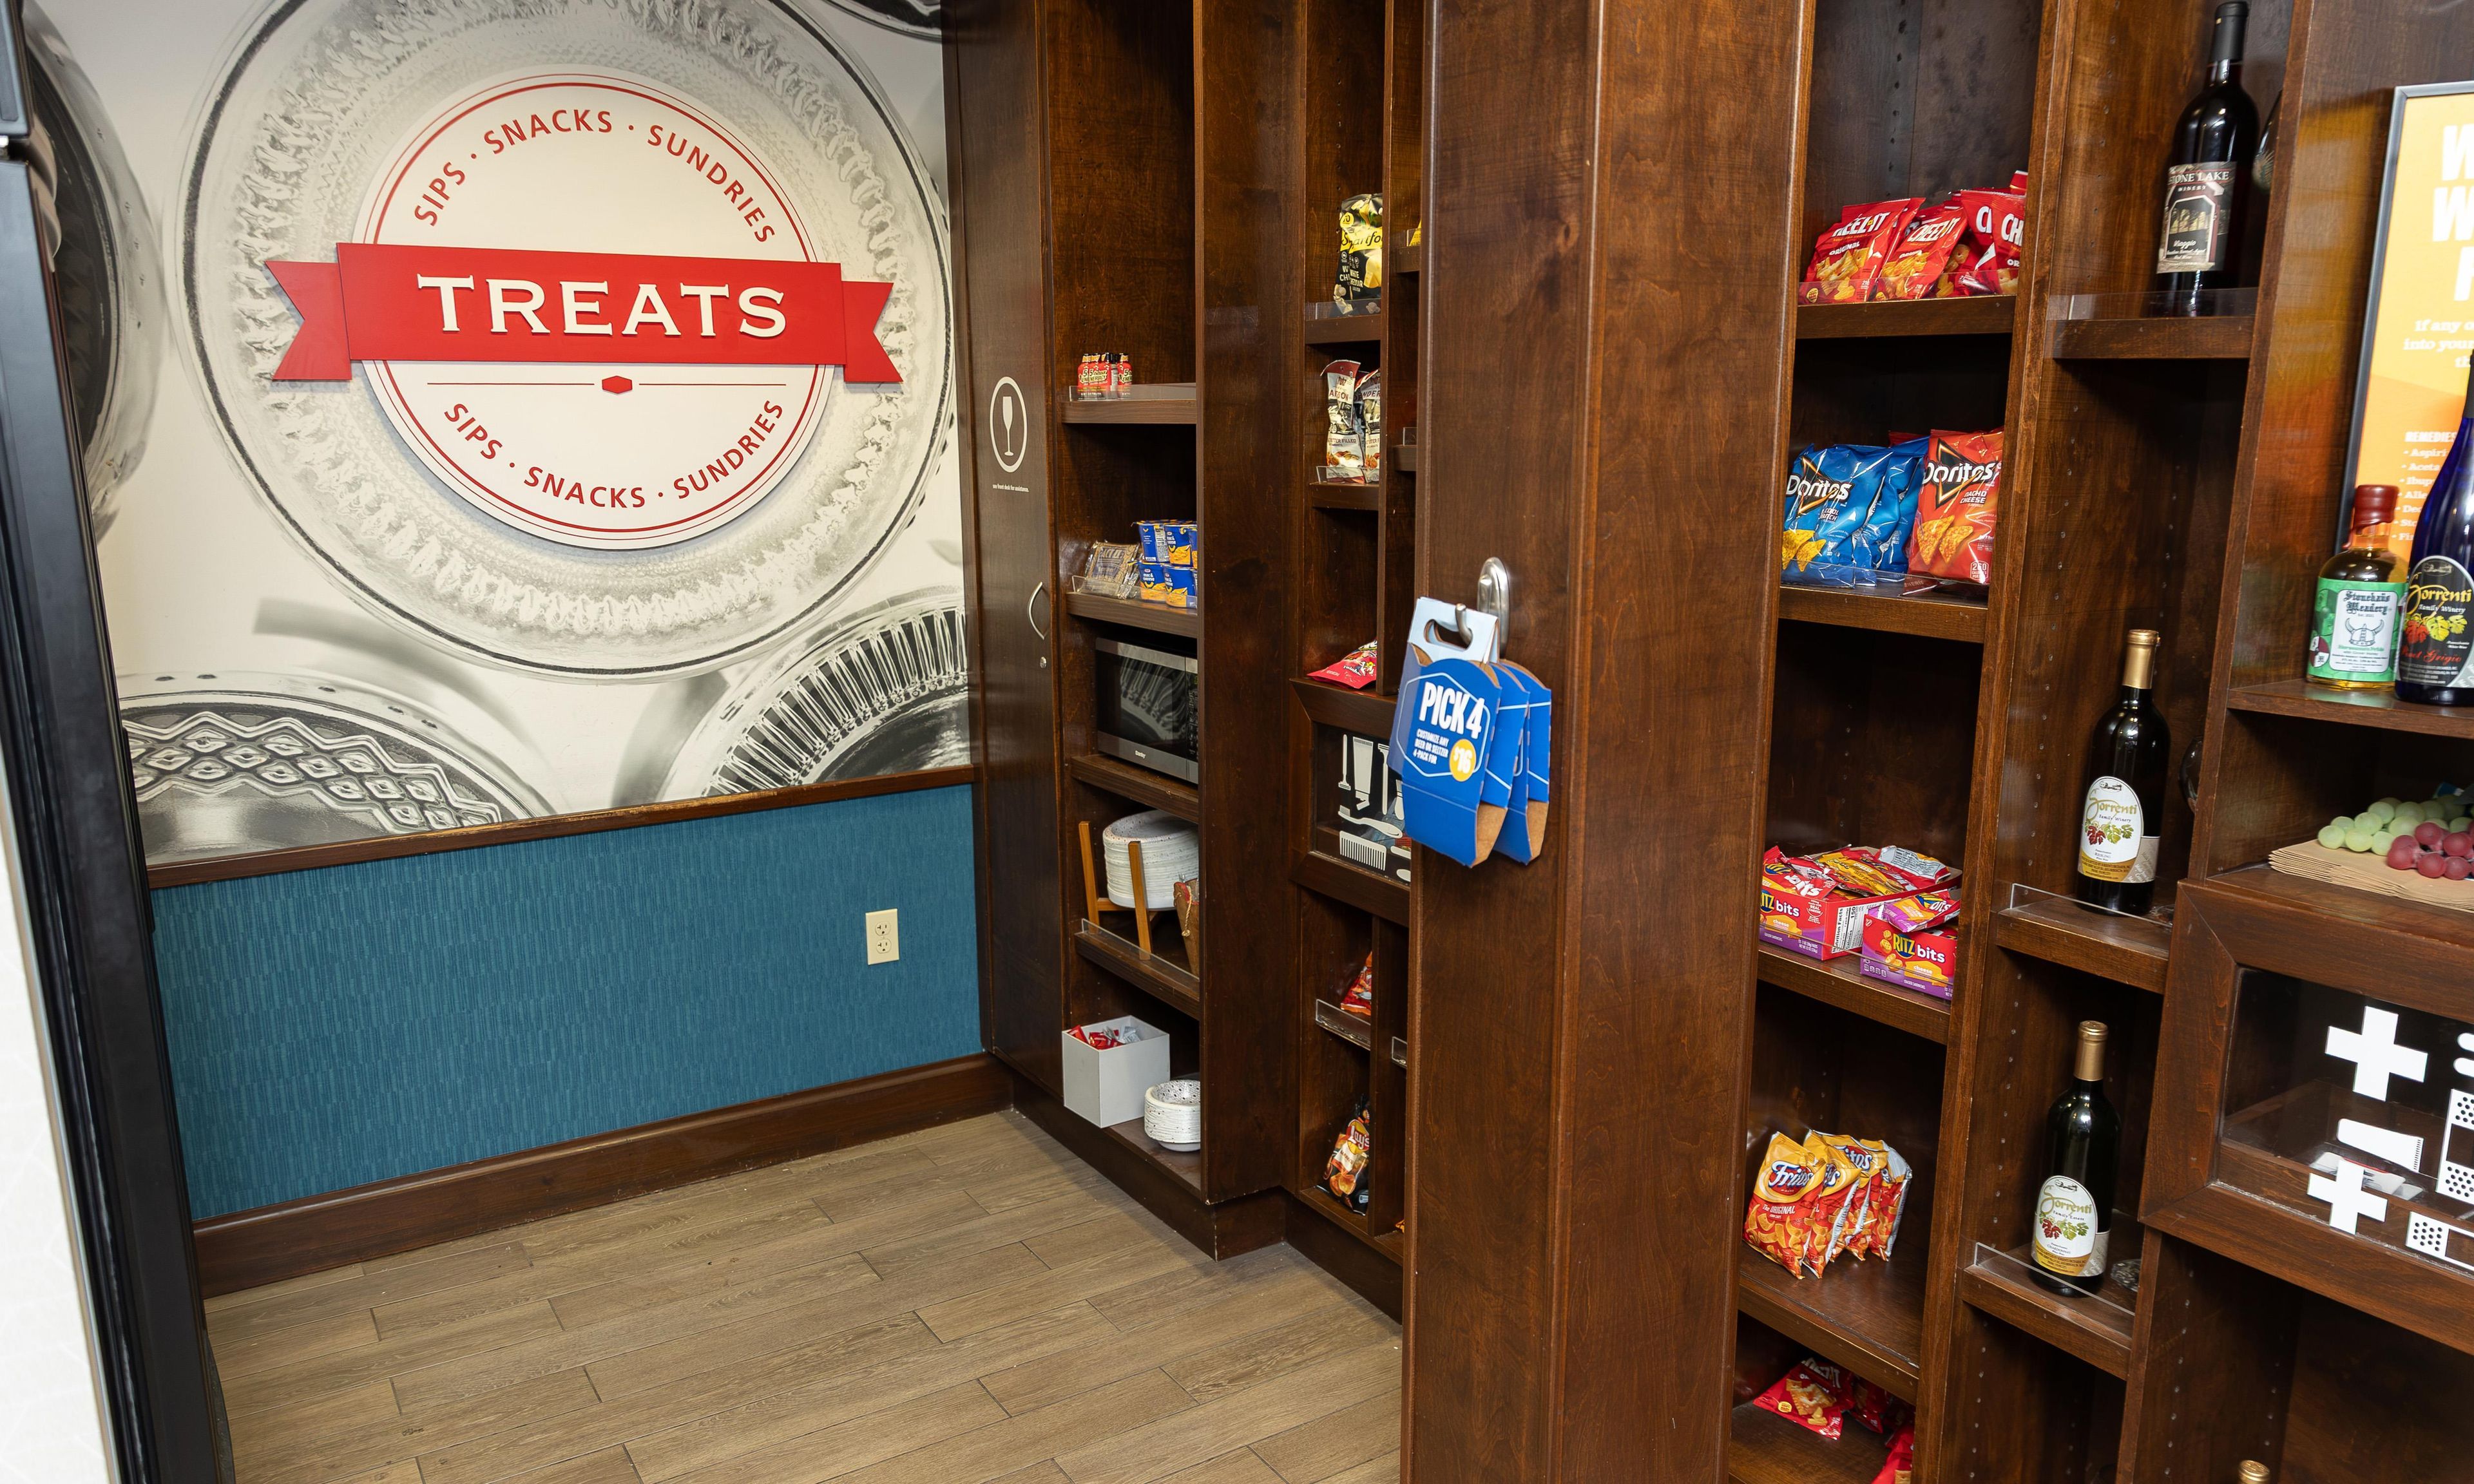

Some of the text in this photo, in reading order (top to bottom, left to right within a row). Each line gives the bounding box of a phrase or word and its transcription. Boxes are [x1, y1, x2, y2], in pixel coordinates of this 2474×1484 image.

[414, 108, 775, 243] SIPS SNACKS SUNDRIES
[2197, 171, 2230, 184] LAKE
[1828, 241, 1861, 256] ORIGINAL
[416, 273, 787, 338] TREATS
[2431, 322, 2460, 334] any
[2403, 338, 2435, 350] into
[444, 400, 783, 509] SIPS SNACKS SUNDRIES
[2410, 448, 2447, 459] Aspiri
[1785, 475, 1853, 501] Doritos
[2440, 605, 2466, 614] Winery
[1419, 681, 1485, 739] PICK 4
[1414, 738, 1449, 758] BEER OR SELTZER
[1417, 728, 1450, 748] CUSTOMIZE ANY
[1413, 748, 1437, 765] 4-PACK FOR
[1453, 746, 1473, 774] $16
[1761, 893, 1800, 917] ITZ bits
[1773, 918, 1790, 927] cheese
[1893, 933, 1946, 963] RITZ bits
[1913, 965, 1933, 975] cheese
[1348, 1125, 1370, 1150] Lay's
[1768, 1160, 1815, 1188] Fritos
[1770, 1205, 1796, 1215] ORIGINAL
